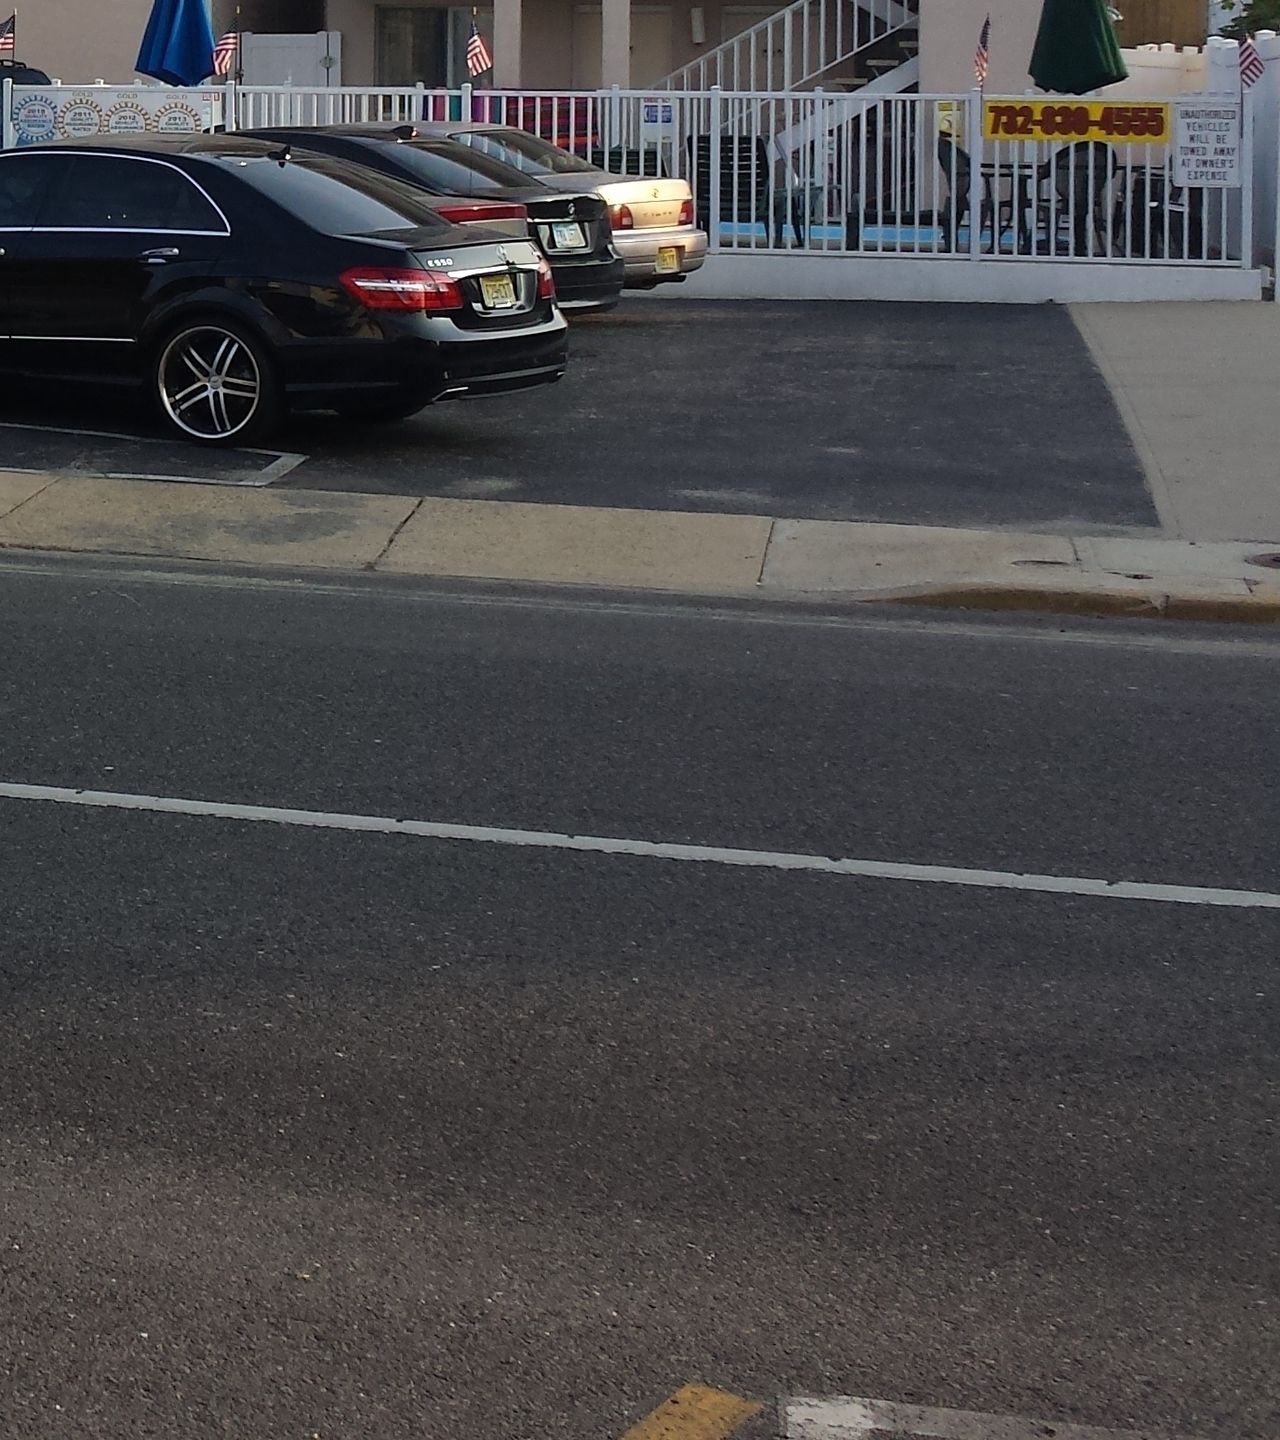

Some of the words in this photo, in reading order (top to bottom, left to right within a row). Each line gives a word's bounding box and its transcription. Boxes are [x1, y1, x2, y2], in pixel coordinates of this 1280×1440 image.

[1186, 122, 1230, 131] VEHICLES
[1189, 134, 1209, 144] WILL
[1216, 134, 1227, 144] BE
[1180, 146, 1206, 156] TOWED
[1213, 147, 1236, 156] AWAY
[1181, 159, 1190, 168] AT
[1187, 171, 1228, 181] EXPENSE
